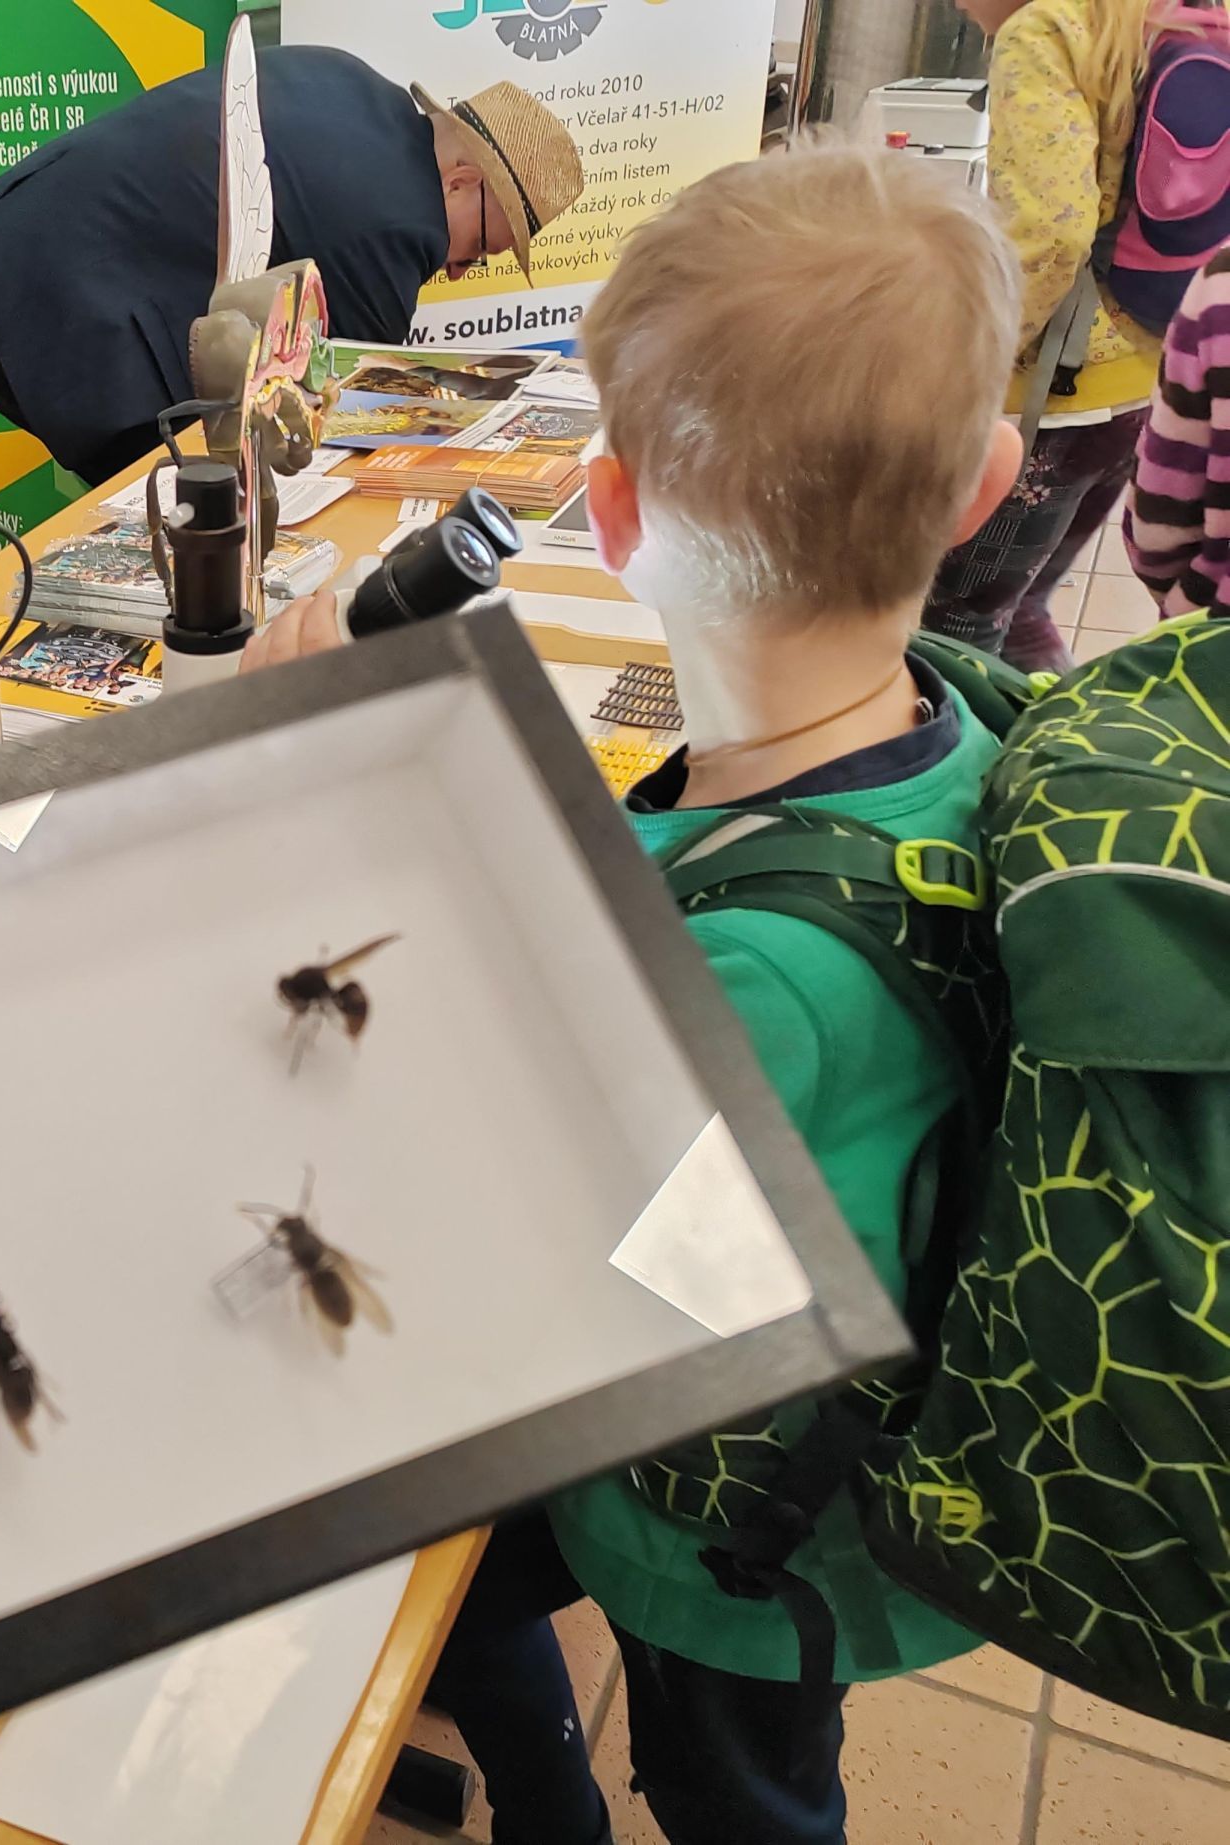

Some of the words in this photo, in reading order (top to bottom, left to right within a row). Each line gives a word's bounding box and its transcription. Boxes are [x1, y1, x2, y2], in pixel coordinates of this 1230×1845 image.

[48, 74, 57, 95] s
[62, 69, 118, 98] výukou
[534, 84, 556, 102] od
[560, 80, 595, 99] roku
[601, 74, 643, 95] 2010
[30, 103, 50, 131] ČR
[65, 106, 85, 130] SR
[577, 106, 628, 127] Včelař
[632, 94, 724, 121] 41-51-H/02
[589, 138, 618, 155] dva
[623, 132, 657, 152] roky
[623, 163, 670, 180] listem
[571, 195, 617, 217] každý
[621, 190, 646, 208] rok
[444, 304, 583, 341] soublatna
